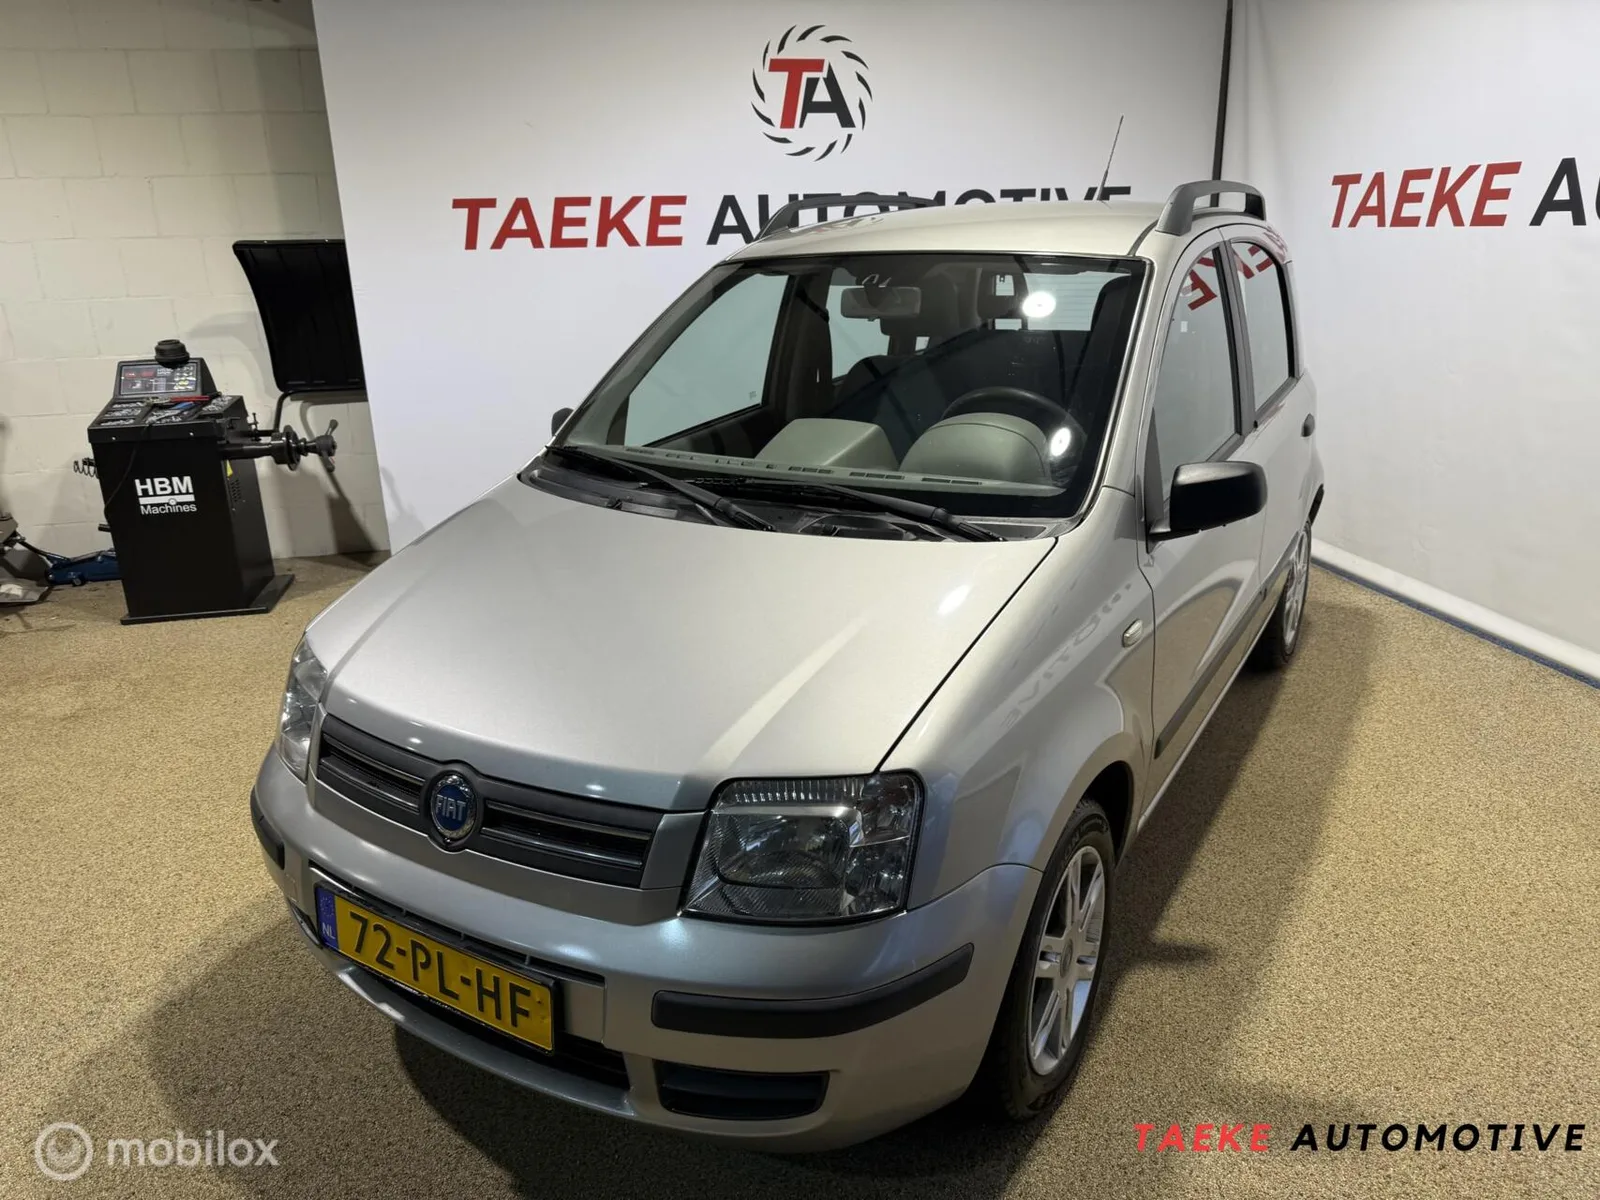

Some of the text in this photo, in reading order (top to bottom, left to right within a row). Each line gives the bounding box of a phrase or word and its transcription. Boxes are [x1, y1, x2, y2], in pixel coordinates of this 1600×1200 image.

[768, 58, 857, 129] TA
[1331, 157, 1600, 228] TAEKE A
[452, 195, 687, 251] TAEKE
[134, 475, 194, 496] HBM
[140, 503, 198, 515] Machines
[435, 794, 467, 821] FIAT
[322, 921, 337, 940] NL
[349, 911, 532, 1028] 72-PL-HF
